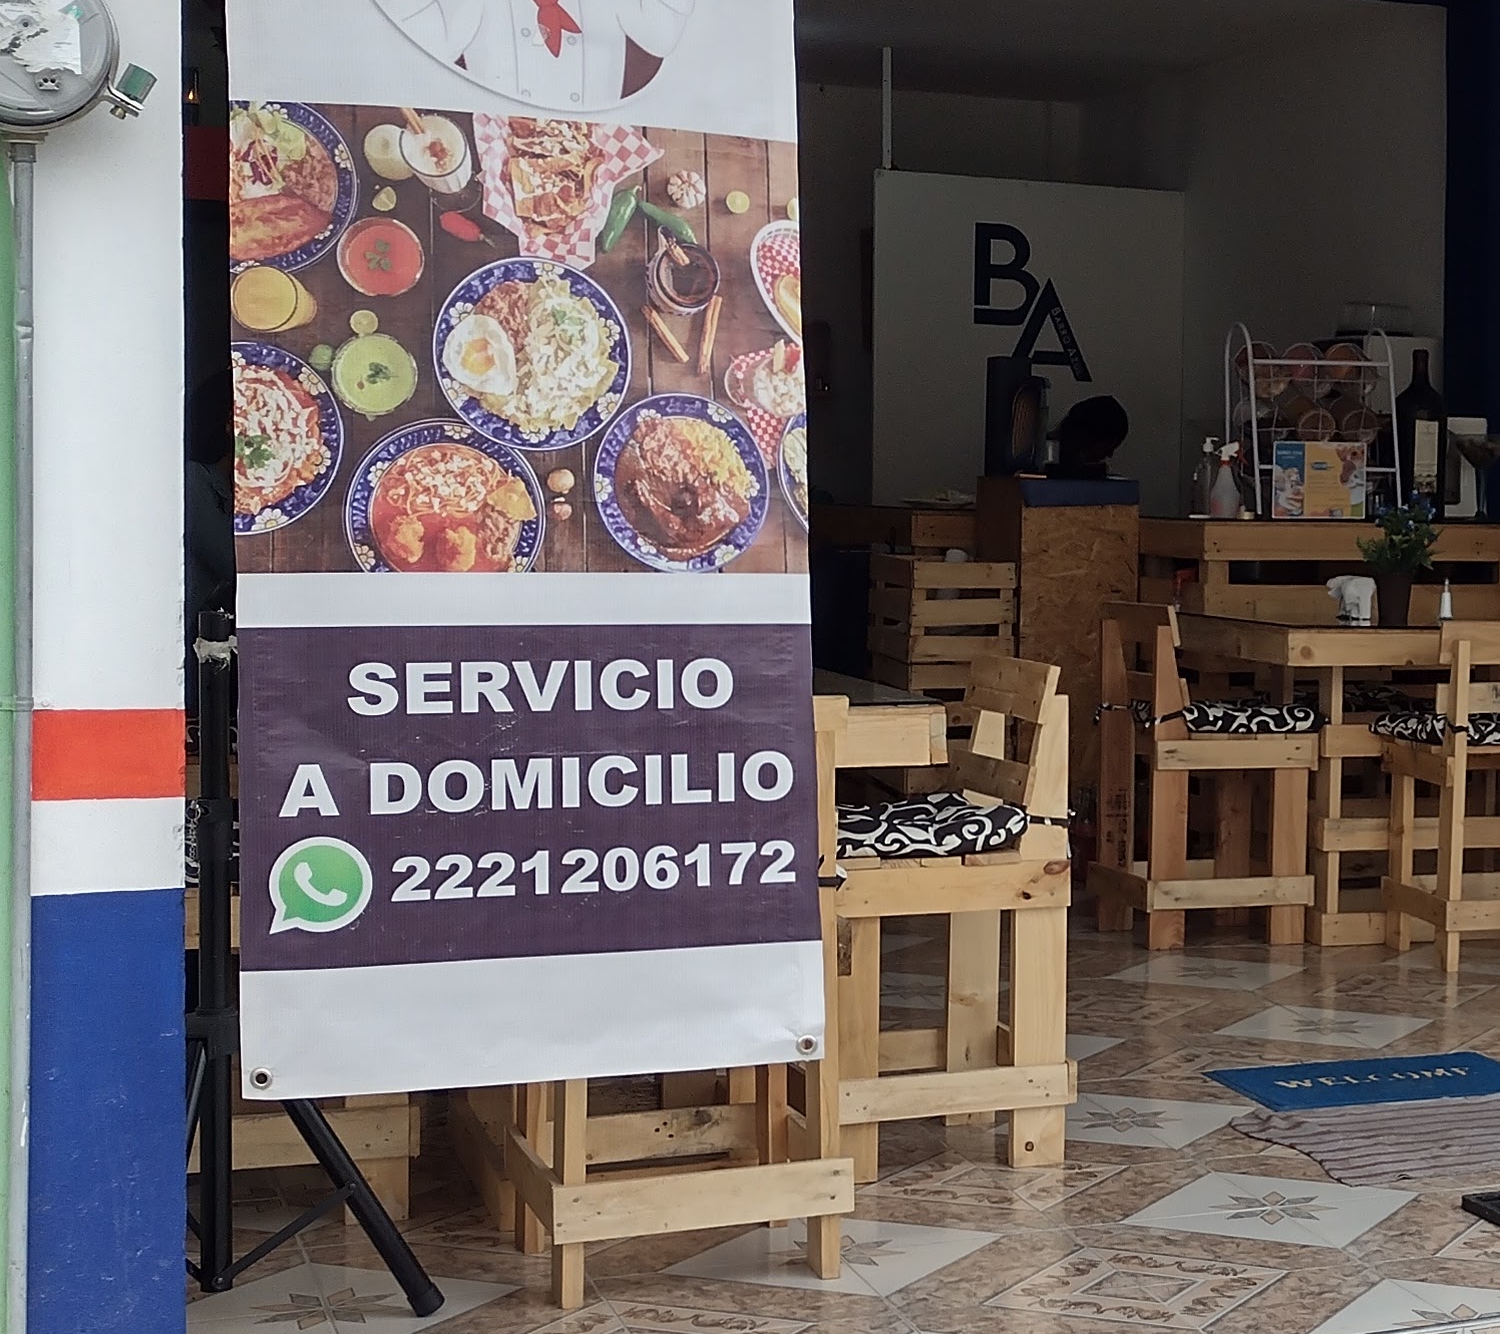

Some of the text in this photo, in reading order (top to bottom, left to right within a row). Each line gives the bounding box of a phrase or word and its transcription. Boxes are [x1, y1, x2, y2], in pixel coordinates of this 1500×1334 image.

[347, 658, 734, 715] SERVICIO
[279, 751, 794, 817] A DOMICILIO
[391, 840, 796, 902] 2221206172
